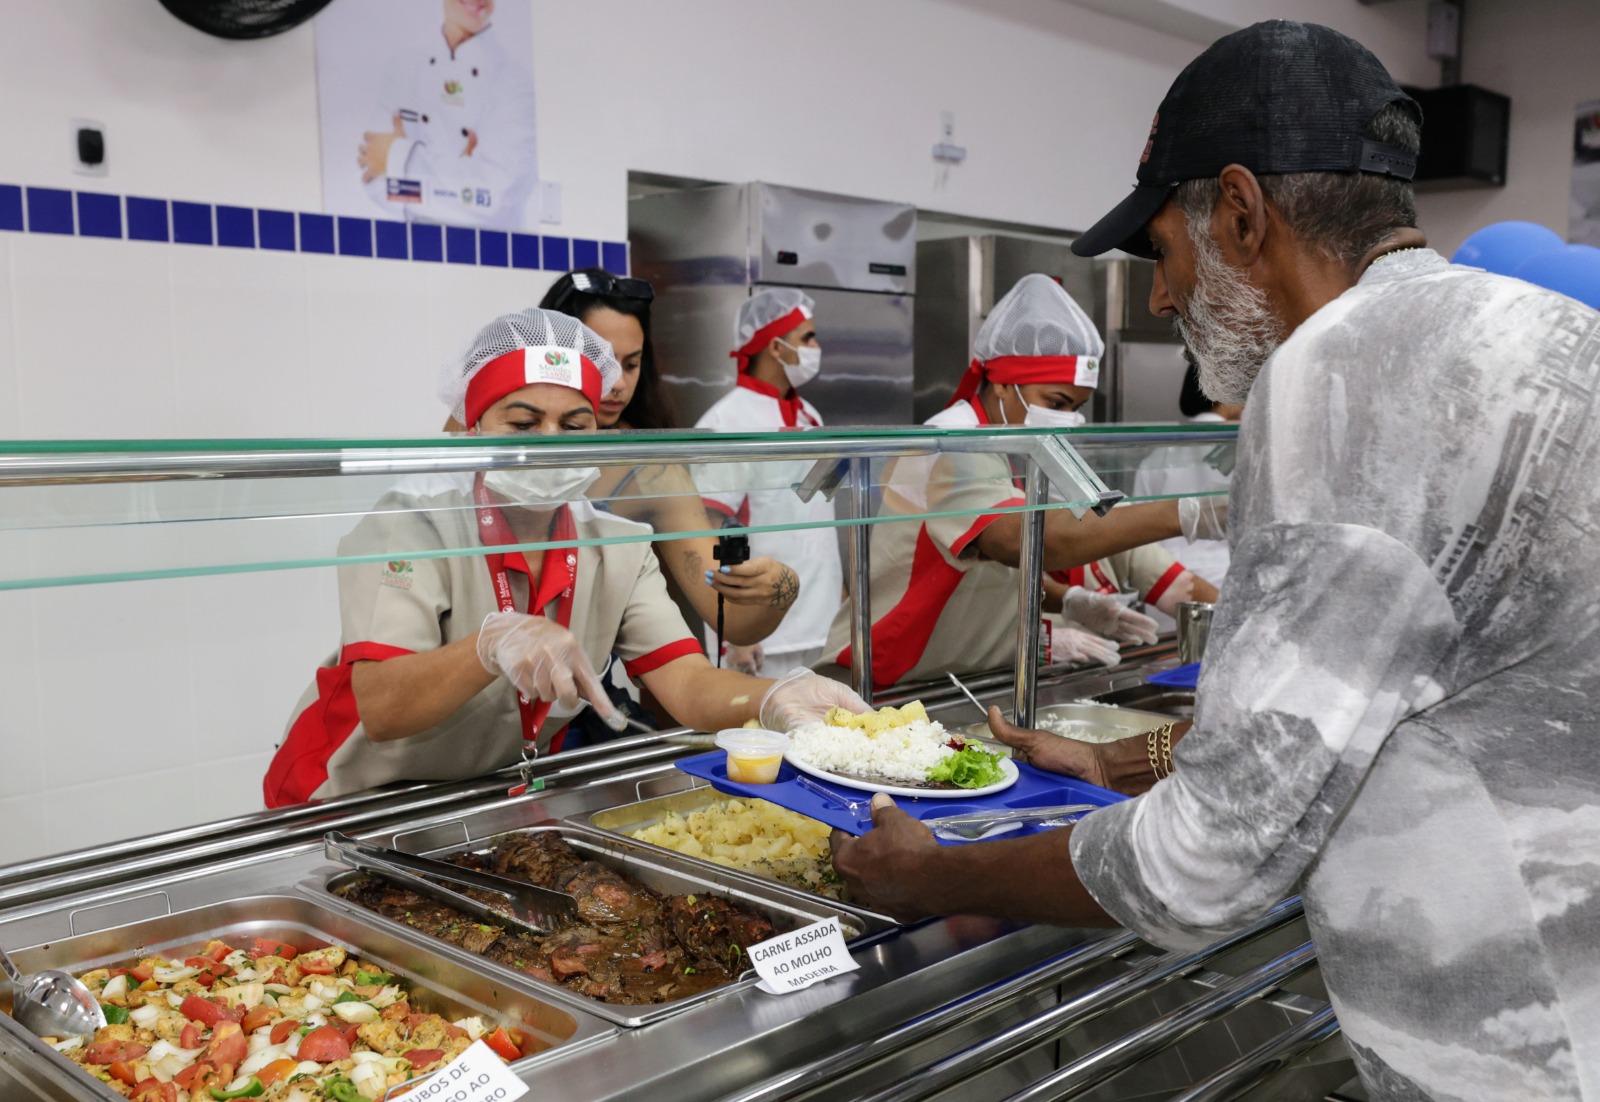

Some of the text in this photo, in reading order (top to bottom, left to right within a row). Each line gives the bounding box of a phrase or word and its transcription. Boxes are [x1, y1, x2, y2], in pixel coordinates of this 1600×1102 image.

[497, 572, 505, 598] Mendes
[754, 923, 837, 962] CARNE ASSADA
[773, 945, 832, 976] AO MOLHO
[787, 964, 839, 987] MADEIRA
[402, 1061, 471, 1102] UBOS DE
[469, 1073, 490, 1092] AO
[482, 1087, 506, 1102] RO
